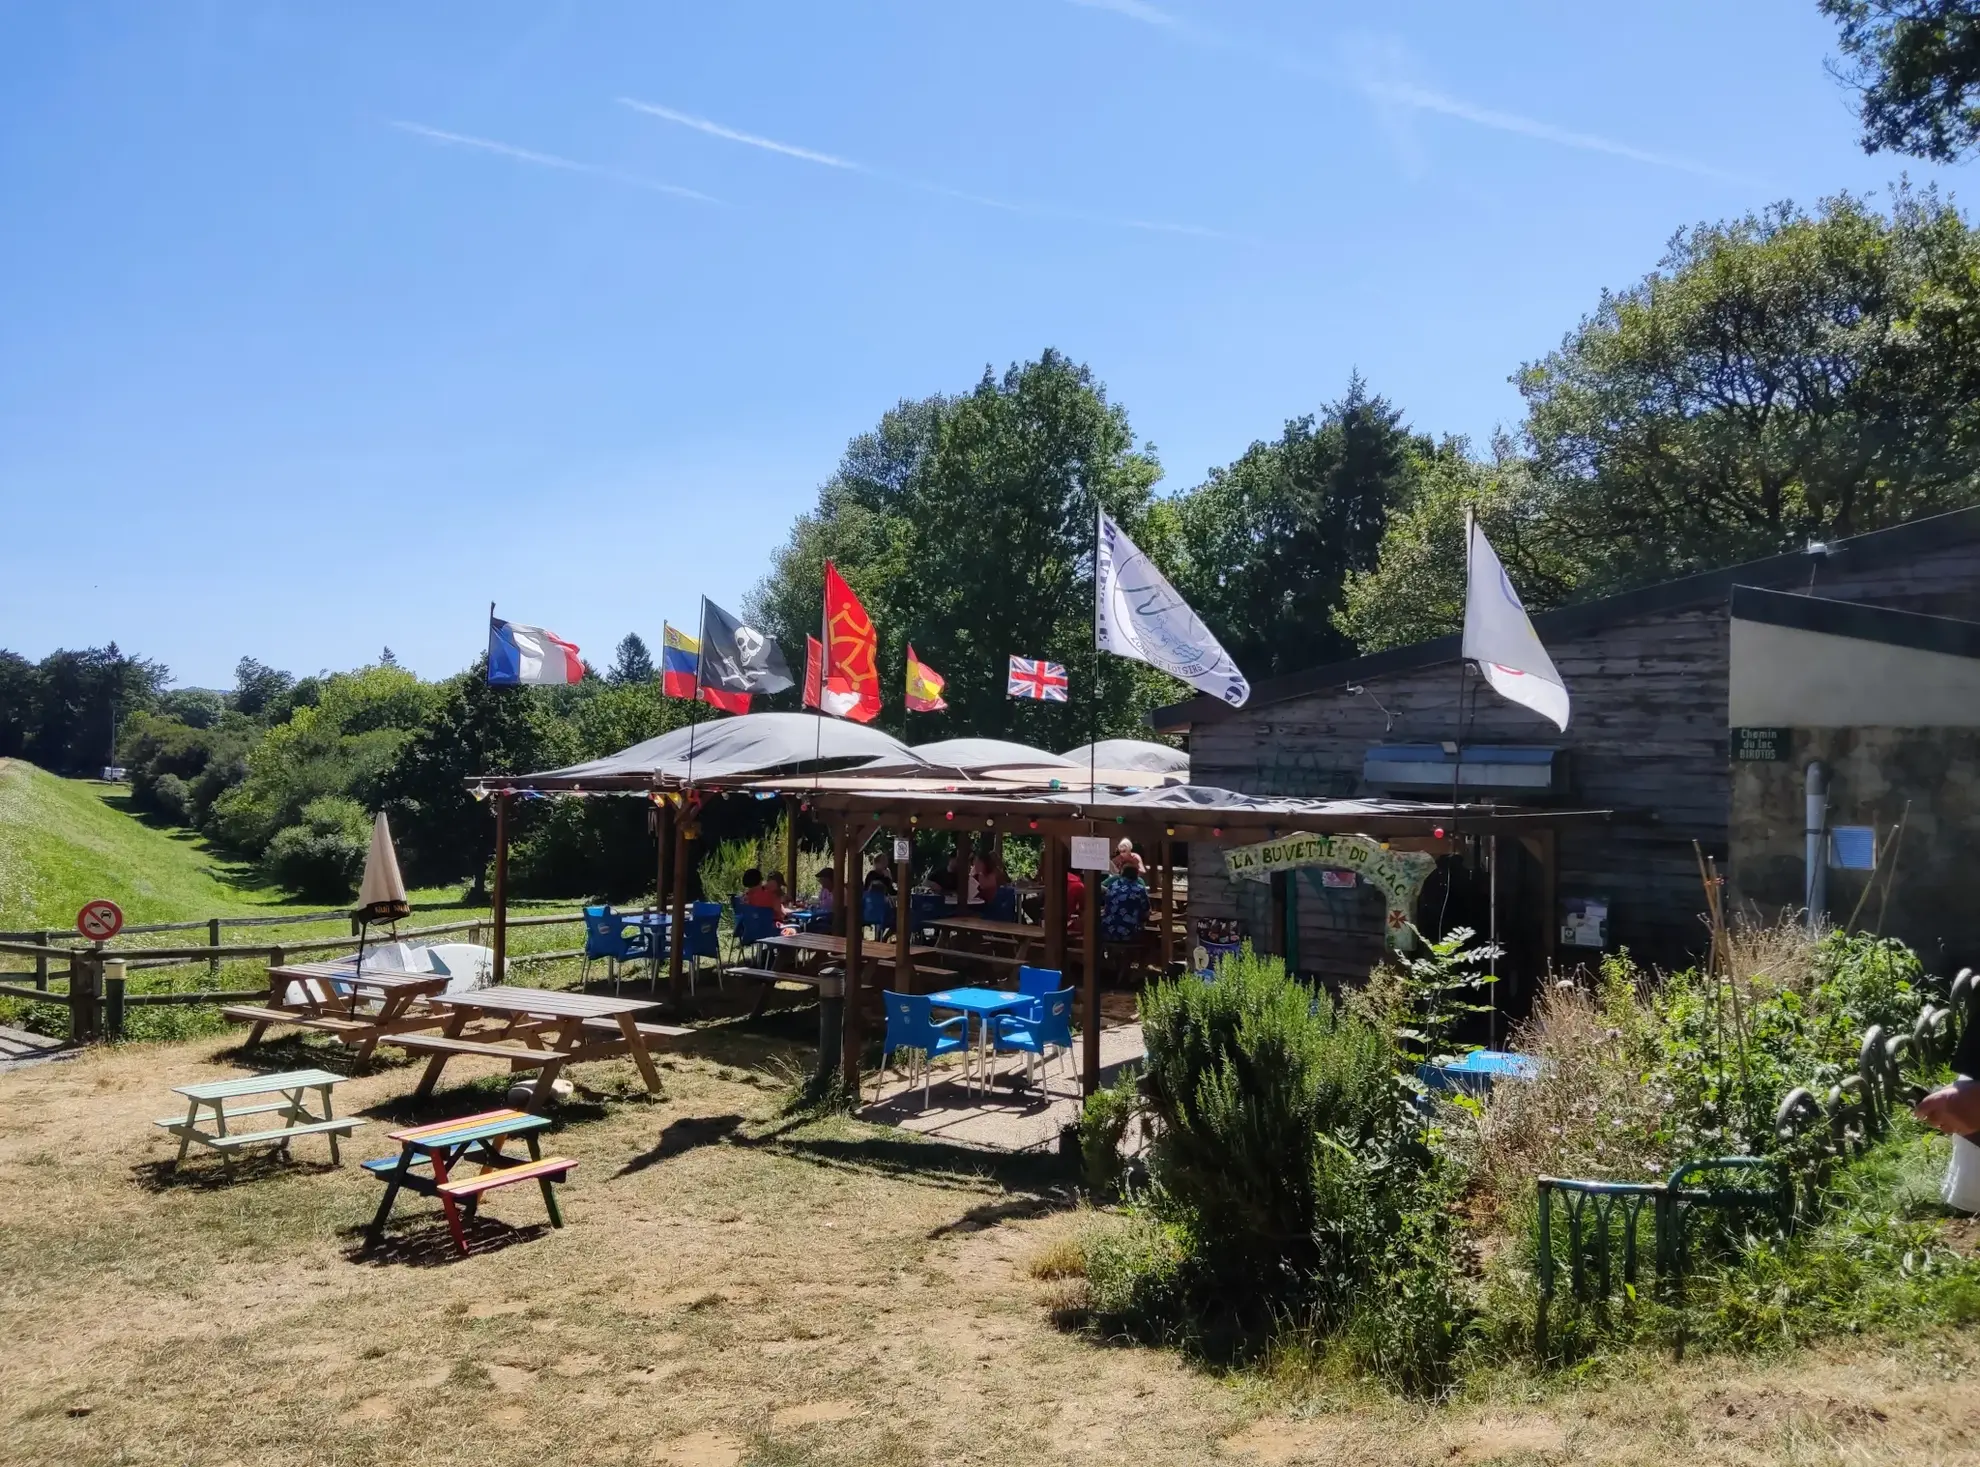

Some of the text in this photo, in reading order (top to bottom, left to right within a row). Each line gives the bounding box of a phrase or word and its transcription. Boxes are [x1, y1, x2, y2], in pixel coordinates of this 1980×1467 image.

[1153, 657, 1164, 668] DE
[1167, 663, 1203, 675] LOISIRS
[1741, 728, 1777, 739] Chemin
[1744, 739, 1755, 749] du
[1231, 840, 1406, 896] LA BUVETTE DU LAC
